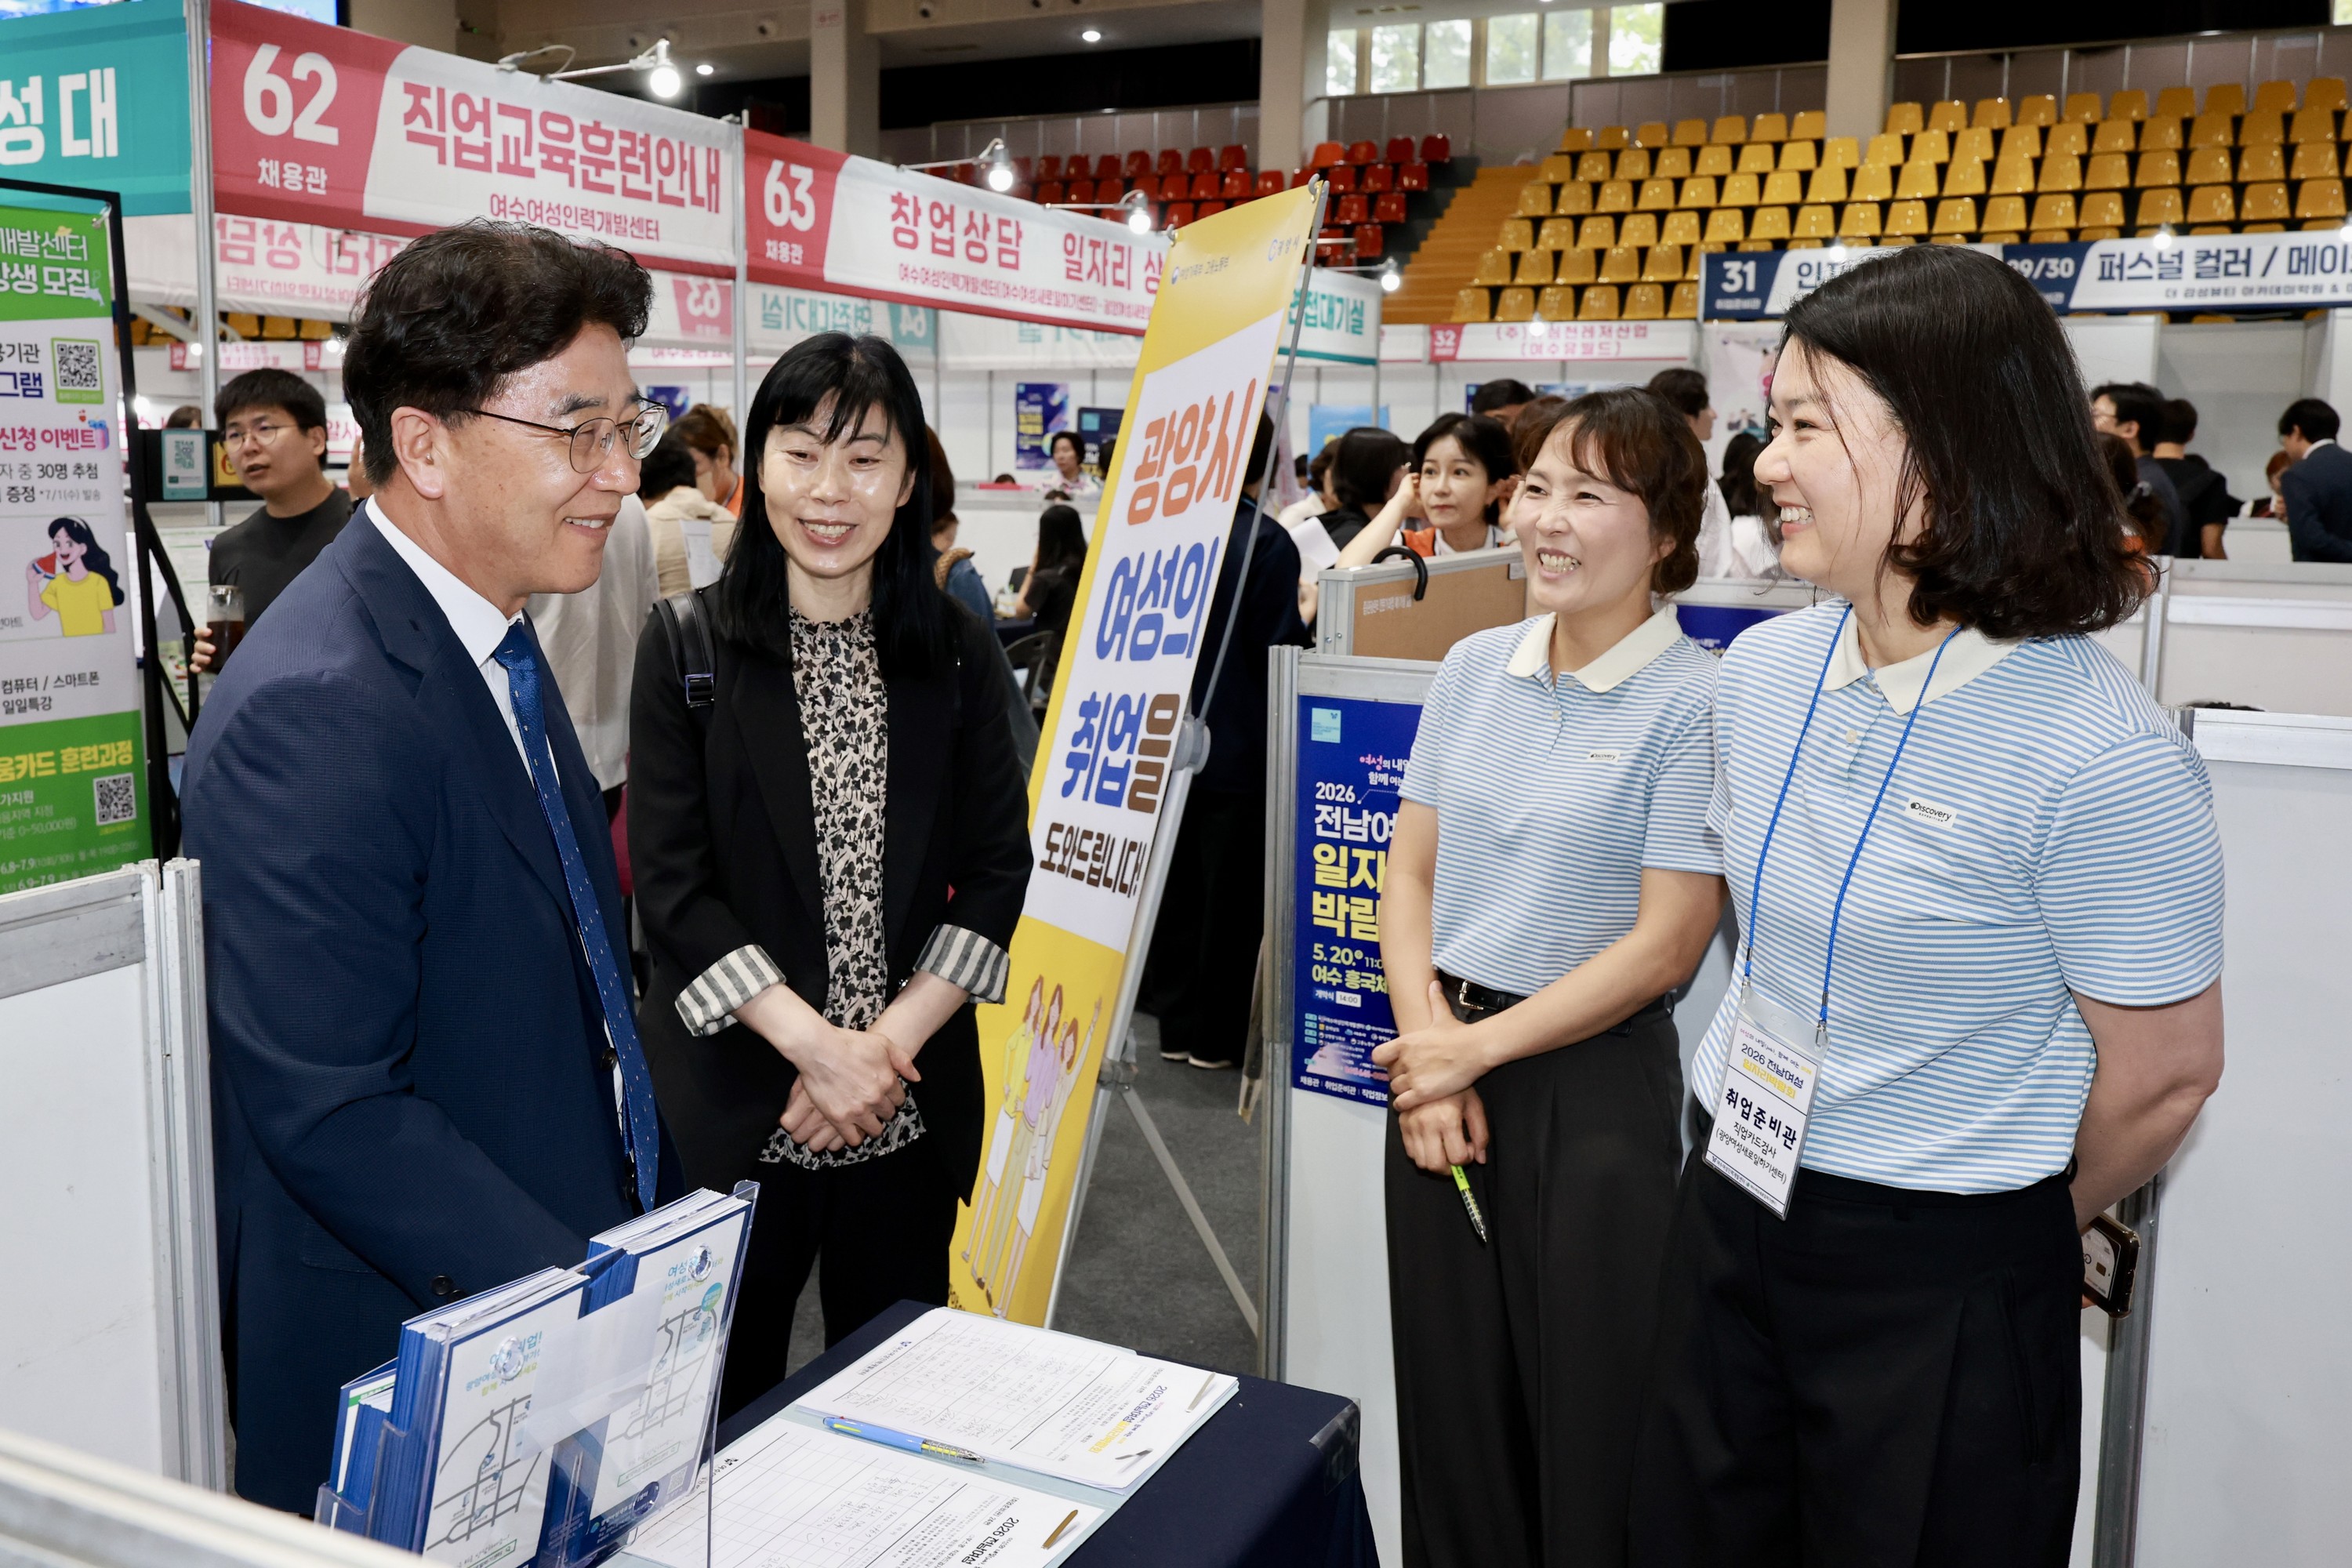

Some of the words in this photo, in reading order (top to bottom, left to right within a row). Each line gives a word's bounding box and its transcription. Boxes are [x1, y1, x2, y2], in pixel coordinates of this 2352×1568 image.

[243, 44, 339, 146] 62
[402, 82, 721, 215] 직업교육훈련안내
[257, 158, 328, 197] 채용관
[764, 160, 816, 232] 63
[490, 194, 661, 241] 여수여성인력개발센터
[765, 238, 804, 266] 채용관
[890, 191, 1024, 271] 창업상담
[1062, 232, 1132, 291] 일자리
[1721, 260, 1756, 293] 31
[2098, 250, 2183, 282] 퍼스널
[2194, 247, 2252, 280] 컬러
[2288, 243, 2352, 277] 메이
[42, 266, 90, 298] 모집
[1434, 329, 1456, 347] 32
[0, 426, 36, 452] 신청
[41, 428, 96, 451] 이벤트
[1127, 377, 1257, 526] 광양시
[36, 463, 68, 480] 30명
[72, 462, 99, 480] 추첨
[6, 485, 35, 503] 증정
[1097, 535, 1219, 662] 여성의
[2, 677, 38, 695] 컴퓨터
[53, 671, 100, 689] 스마트폰
[2, 695, 53, 715] 일일특강
[60, 739, 134, 774] 훈련과정
[1061, 690, 1181, 815] 취업을
[1359, 753, 1392, 771] 여성의
[1315, 781, 1356, 804] 2026
[1368, 771, 1389, 786] 함께
[1914, 801, 1952, 822] Discovery
[1312, 842, 1387, 894] 일자
[1312, 964, 1343, 987] 여수
[1338, 994, 1359, 1004] 14:00
[1741, 1043, 1766, 1065] 2026
[1767, 1059, 1804, 1090] 전남여성
[1743, 1058, 1797, 1100] 일자리박람회
[1300, 1075, 1320, 1088] 채용관
[1324, 1080, 1356, 1096] 취업준비관
[1726, 1087, 1797, 1151] 취업준비관
[1715, 1127, 1788, 1185] (광양여성새로일하기센터)
[1733, 1121, 1777, 1160] 직업카드검사
[1146, 1385, 1167, 1405] 2026
[1123, 1401, 1150, 1425] 전남여성
[993, 1517, 1019, 1541] 2026
[961, 1533, 1001, 1564] 전남여성
